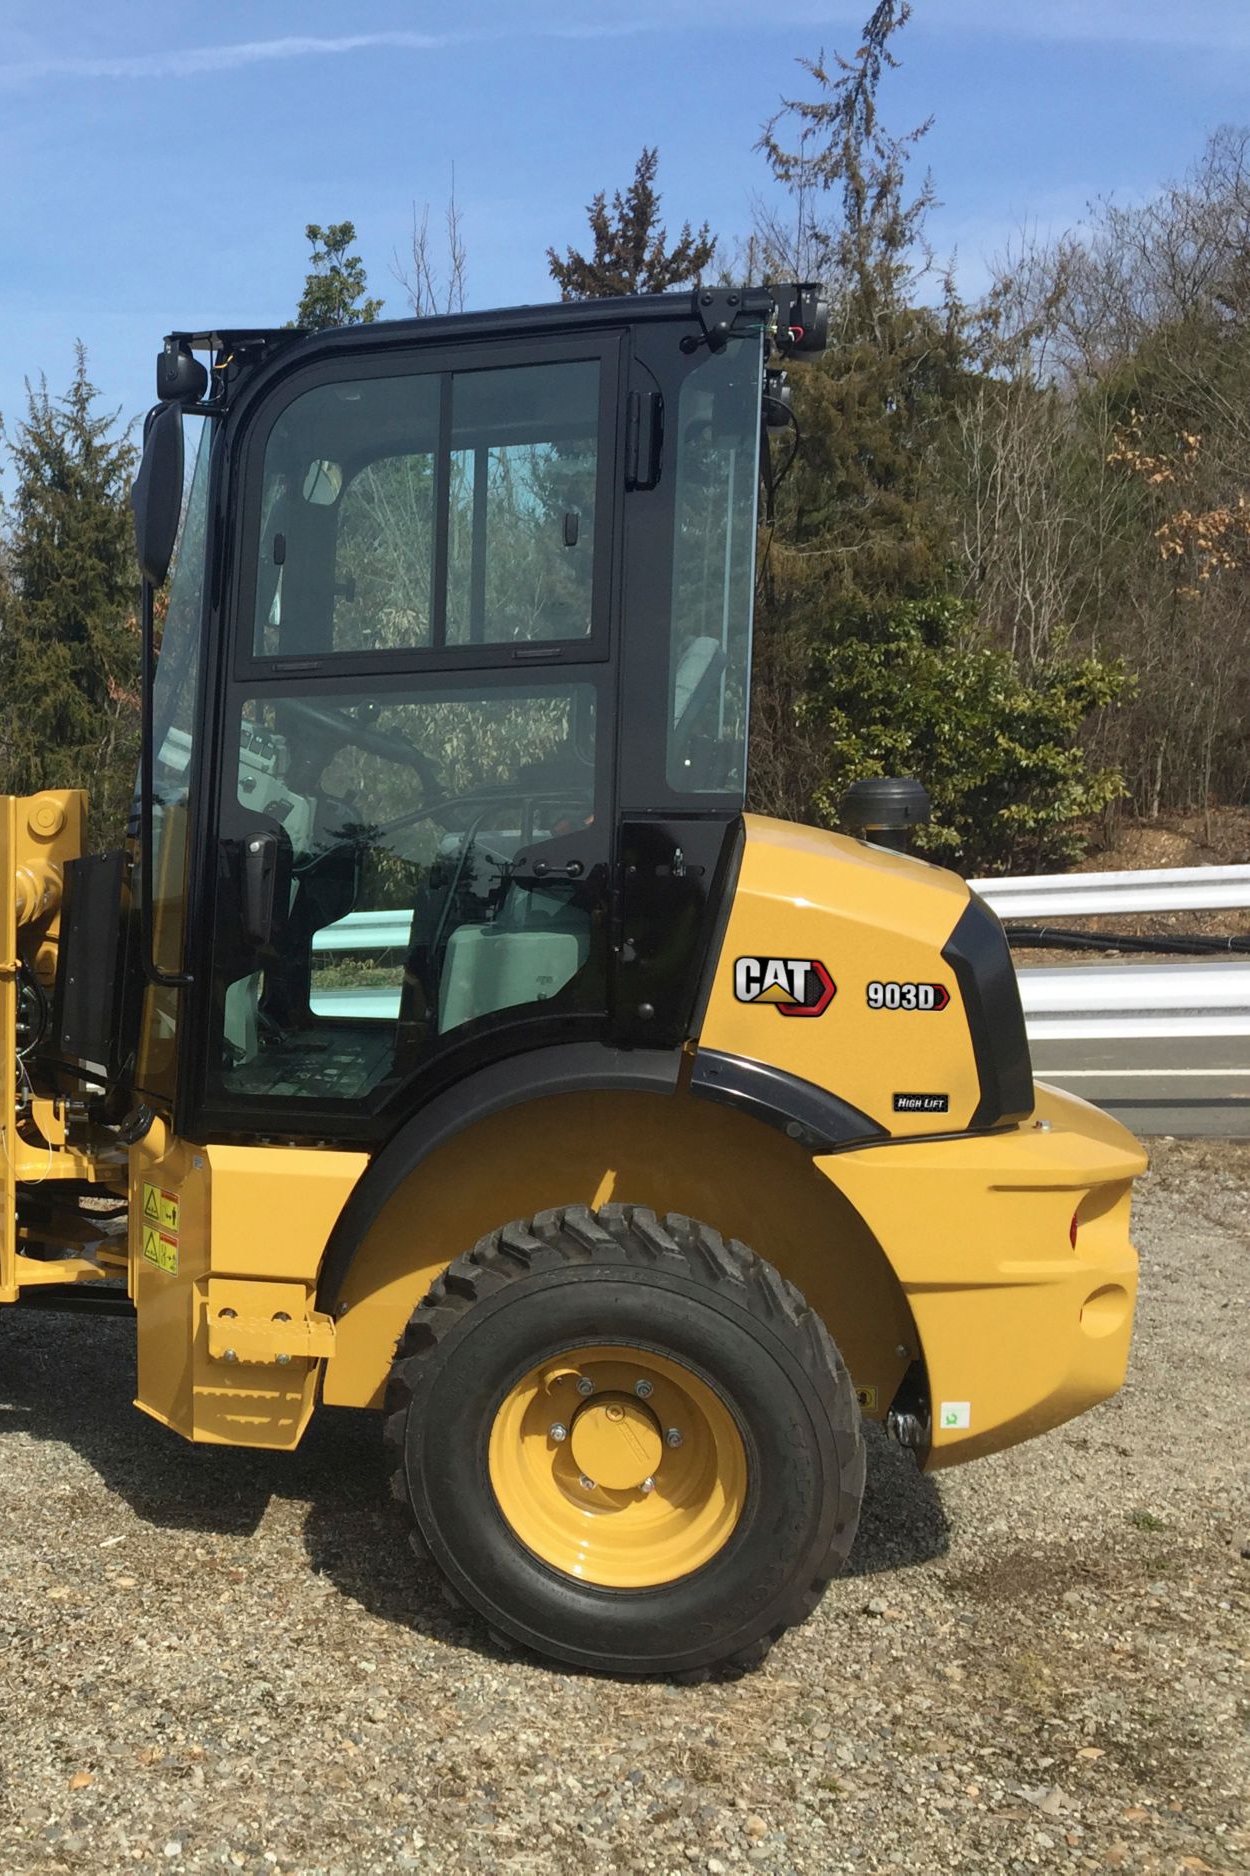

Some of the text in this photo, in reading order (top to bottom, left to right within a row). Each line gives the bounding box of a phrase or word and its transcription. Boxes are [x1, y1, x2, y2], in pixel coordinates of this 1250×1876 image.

[735, 957, 812, 1004] CAT
[868, 982, 935, 1009] 903D
[897, 1098, 945, 1109] HIGH LIFT
